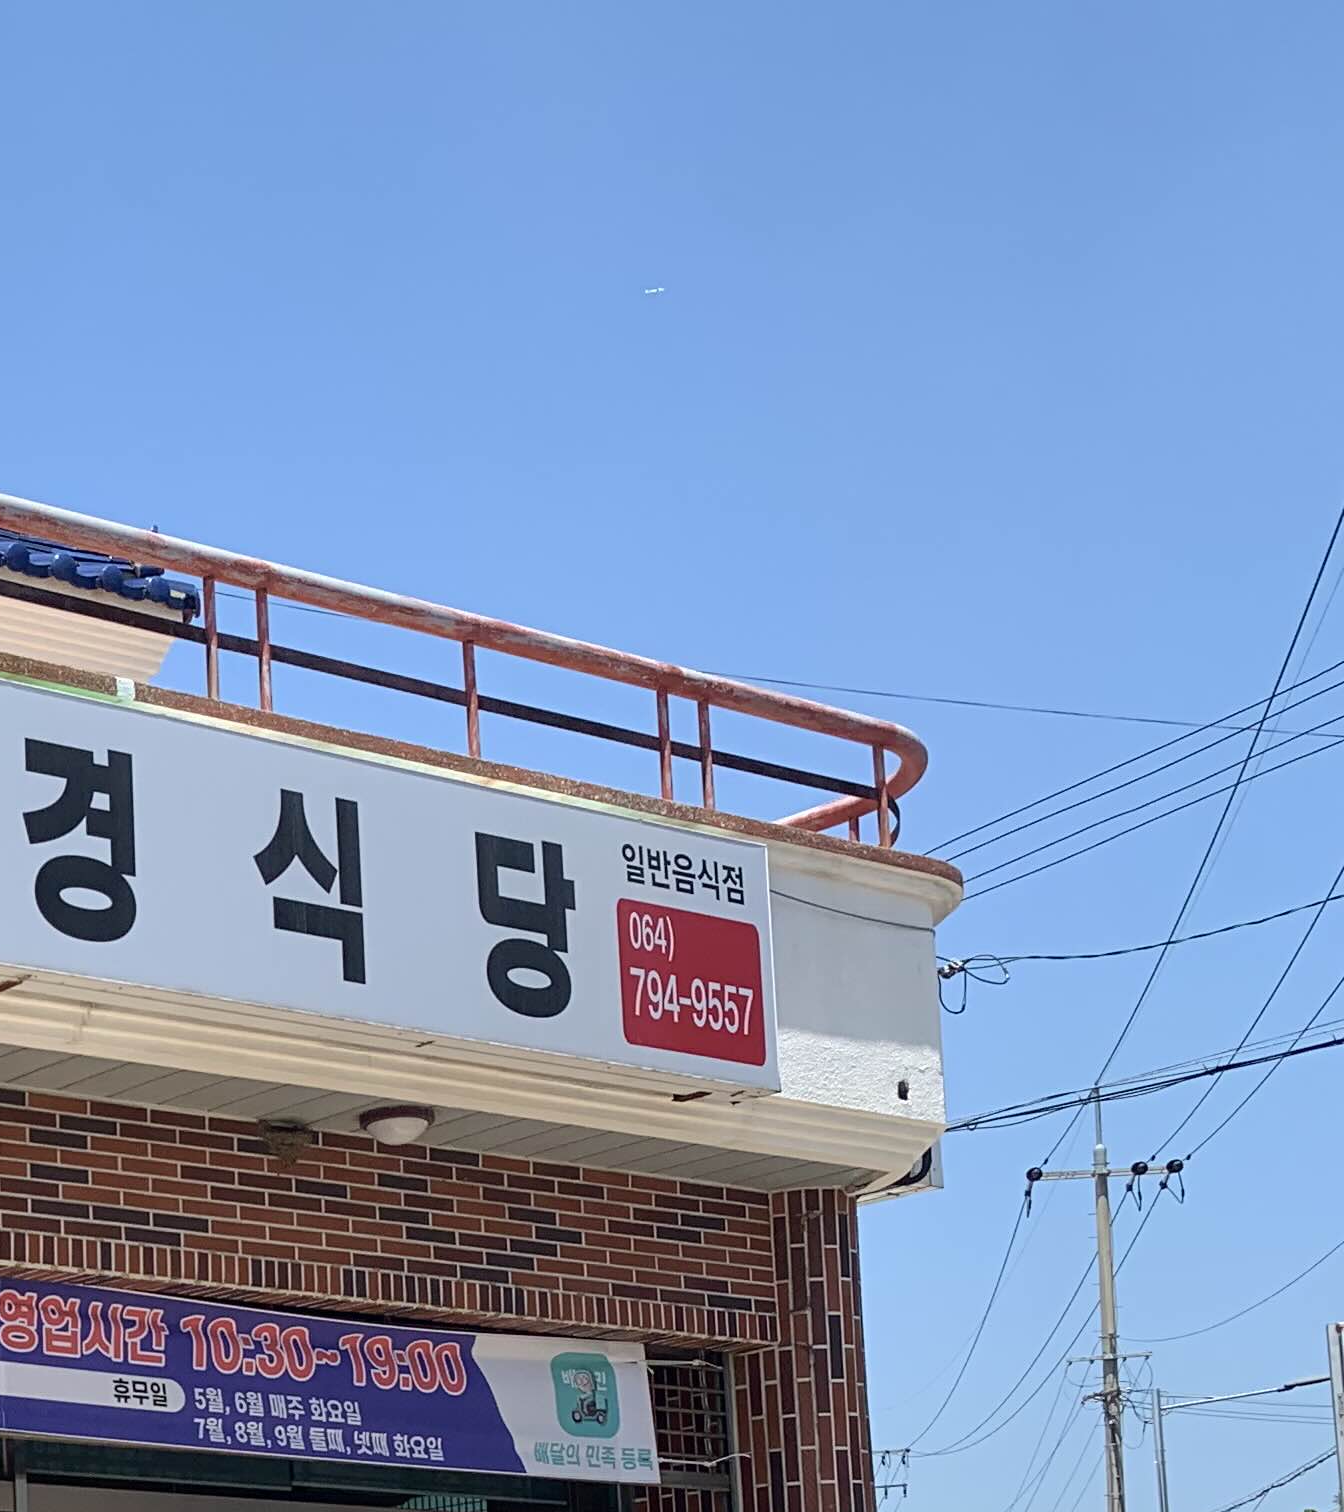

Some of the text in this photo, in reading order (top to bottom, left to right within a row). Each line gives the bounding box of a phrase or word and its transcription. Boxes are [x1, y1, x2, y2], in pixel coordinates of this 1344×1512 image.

[622, 843, 745, 905] 일반음식점
[628, 912, 675, 962] 064)
[629, 967, 754, 1035] 794-9557
[185, 1314, 467, 1395] 10:30~19:00
[112, 1378, 169, 1408] 휴무일
[268, 1394, 305, 1420] 매주
[309, 1397, 362, 1426] 화요일
[393, 1433, 445, 1461] 화요일
[534, 1441, 653, 1471] 배달의 민족 등록
